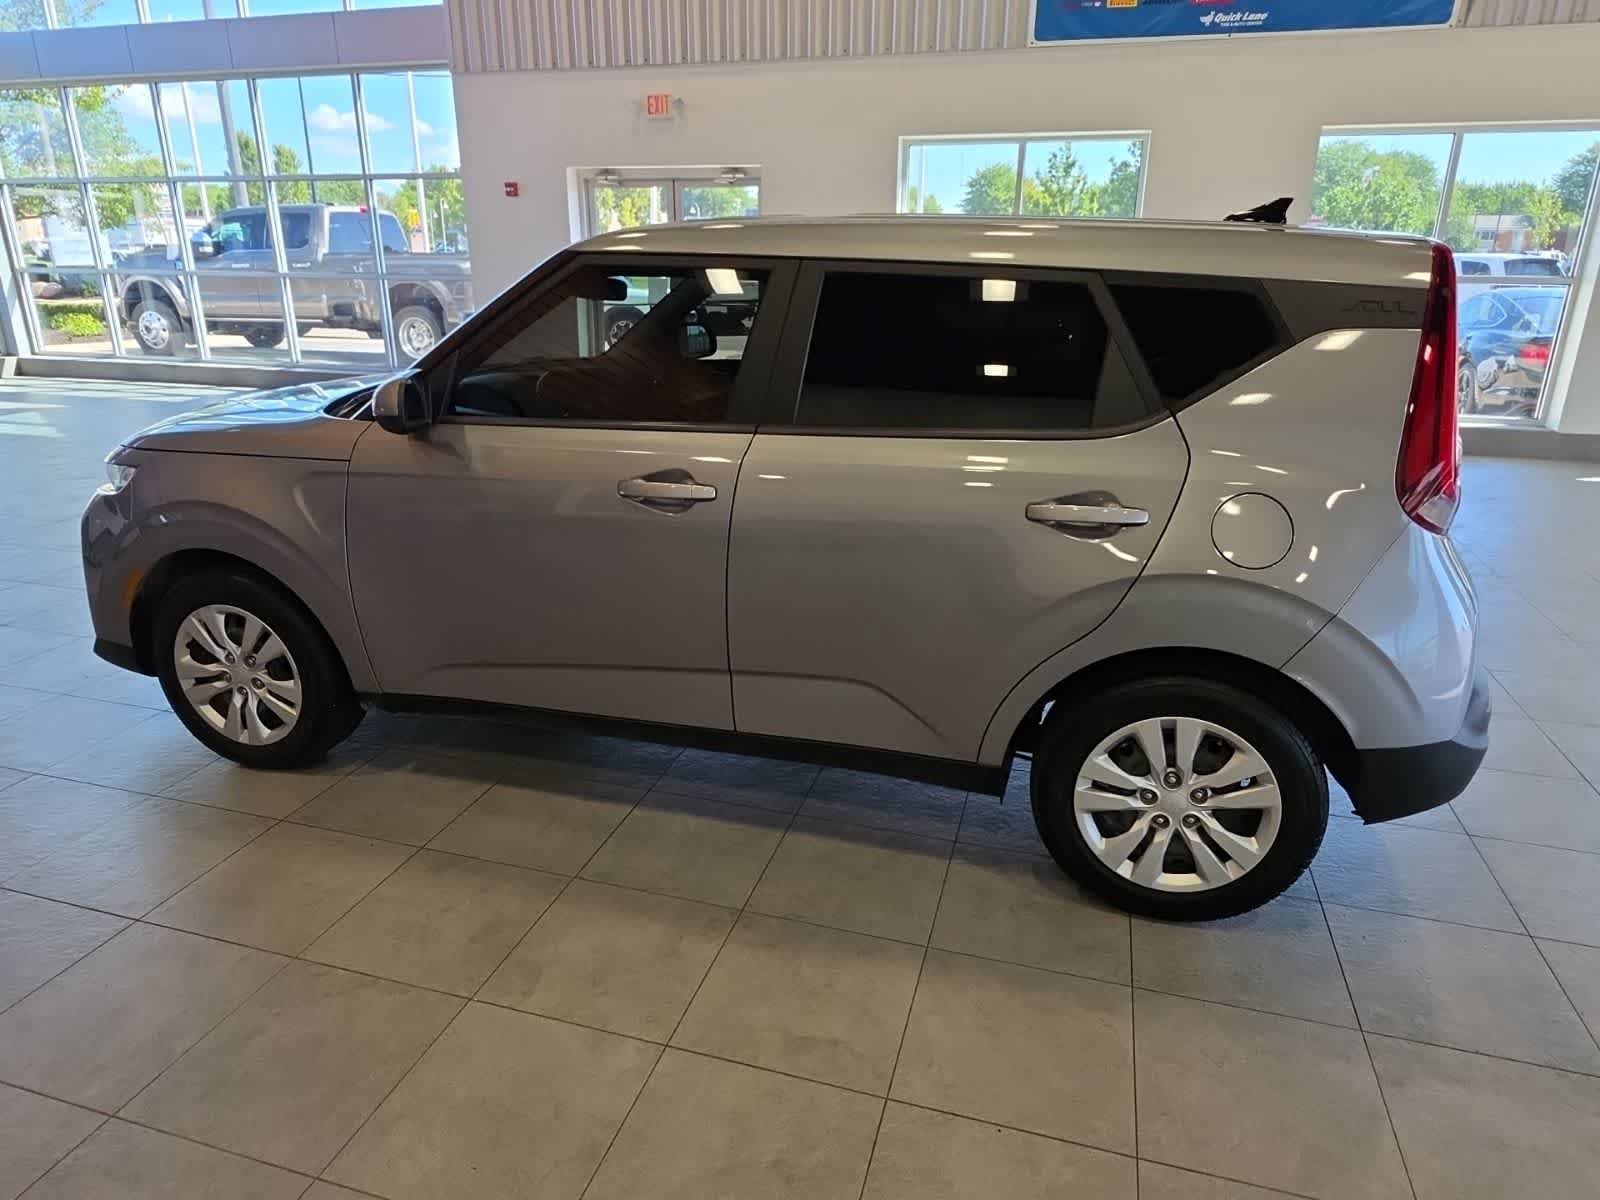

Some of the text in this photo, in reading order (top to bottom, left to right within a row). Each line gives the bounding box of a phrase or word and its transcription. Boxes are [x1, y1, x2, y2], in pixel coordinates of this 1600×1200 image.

[1214, 11, 1268, 23] Quick Lane
[647, 95, 671, 115] EXIT
